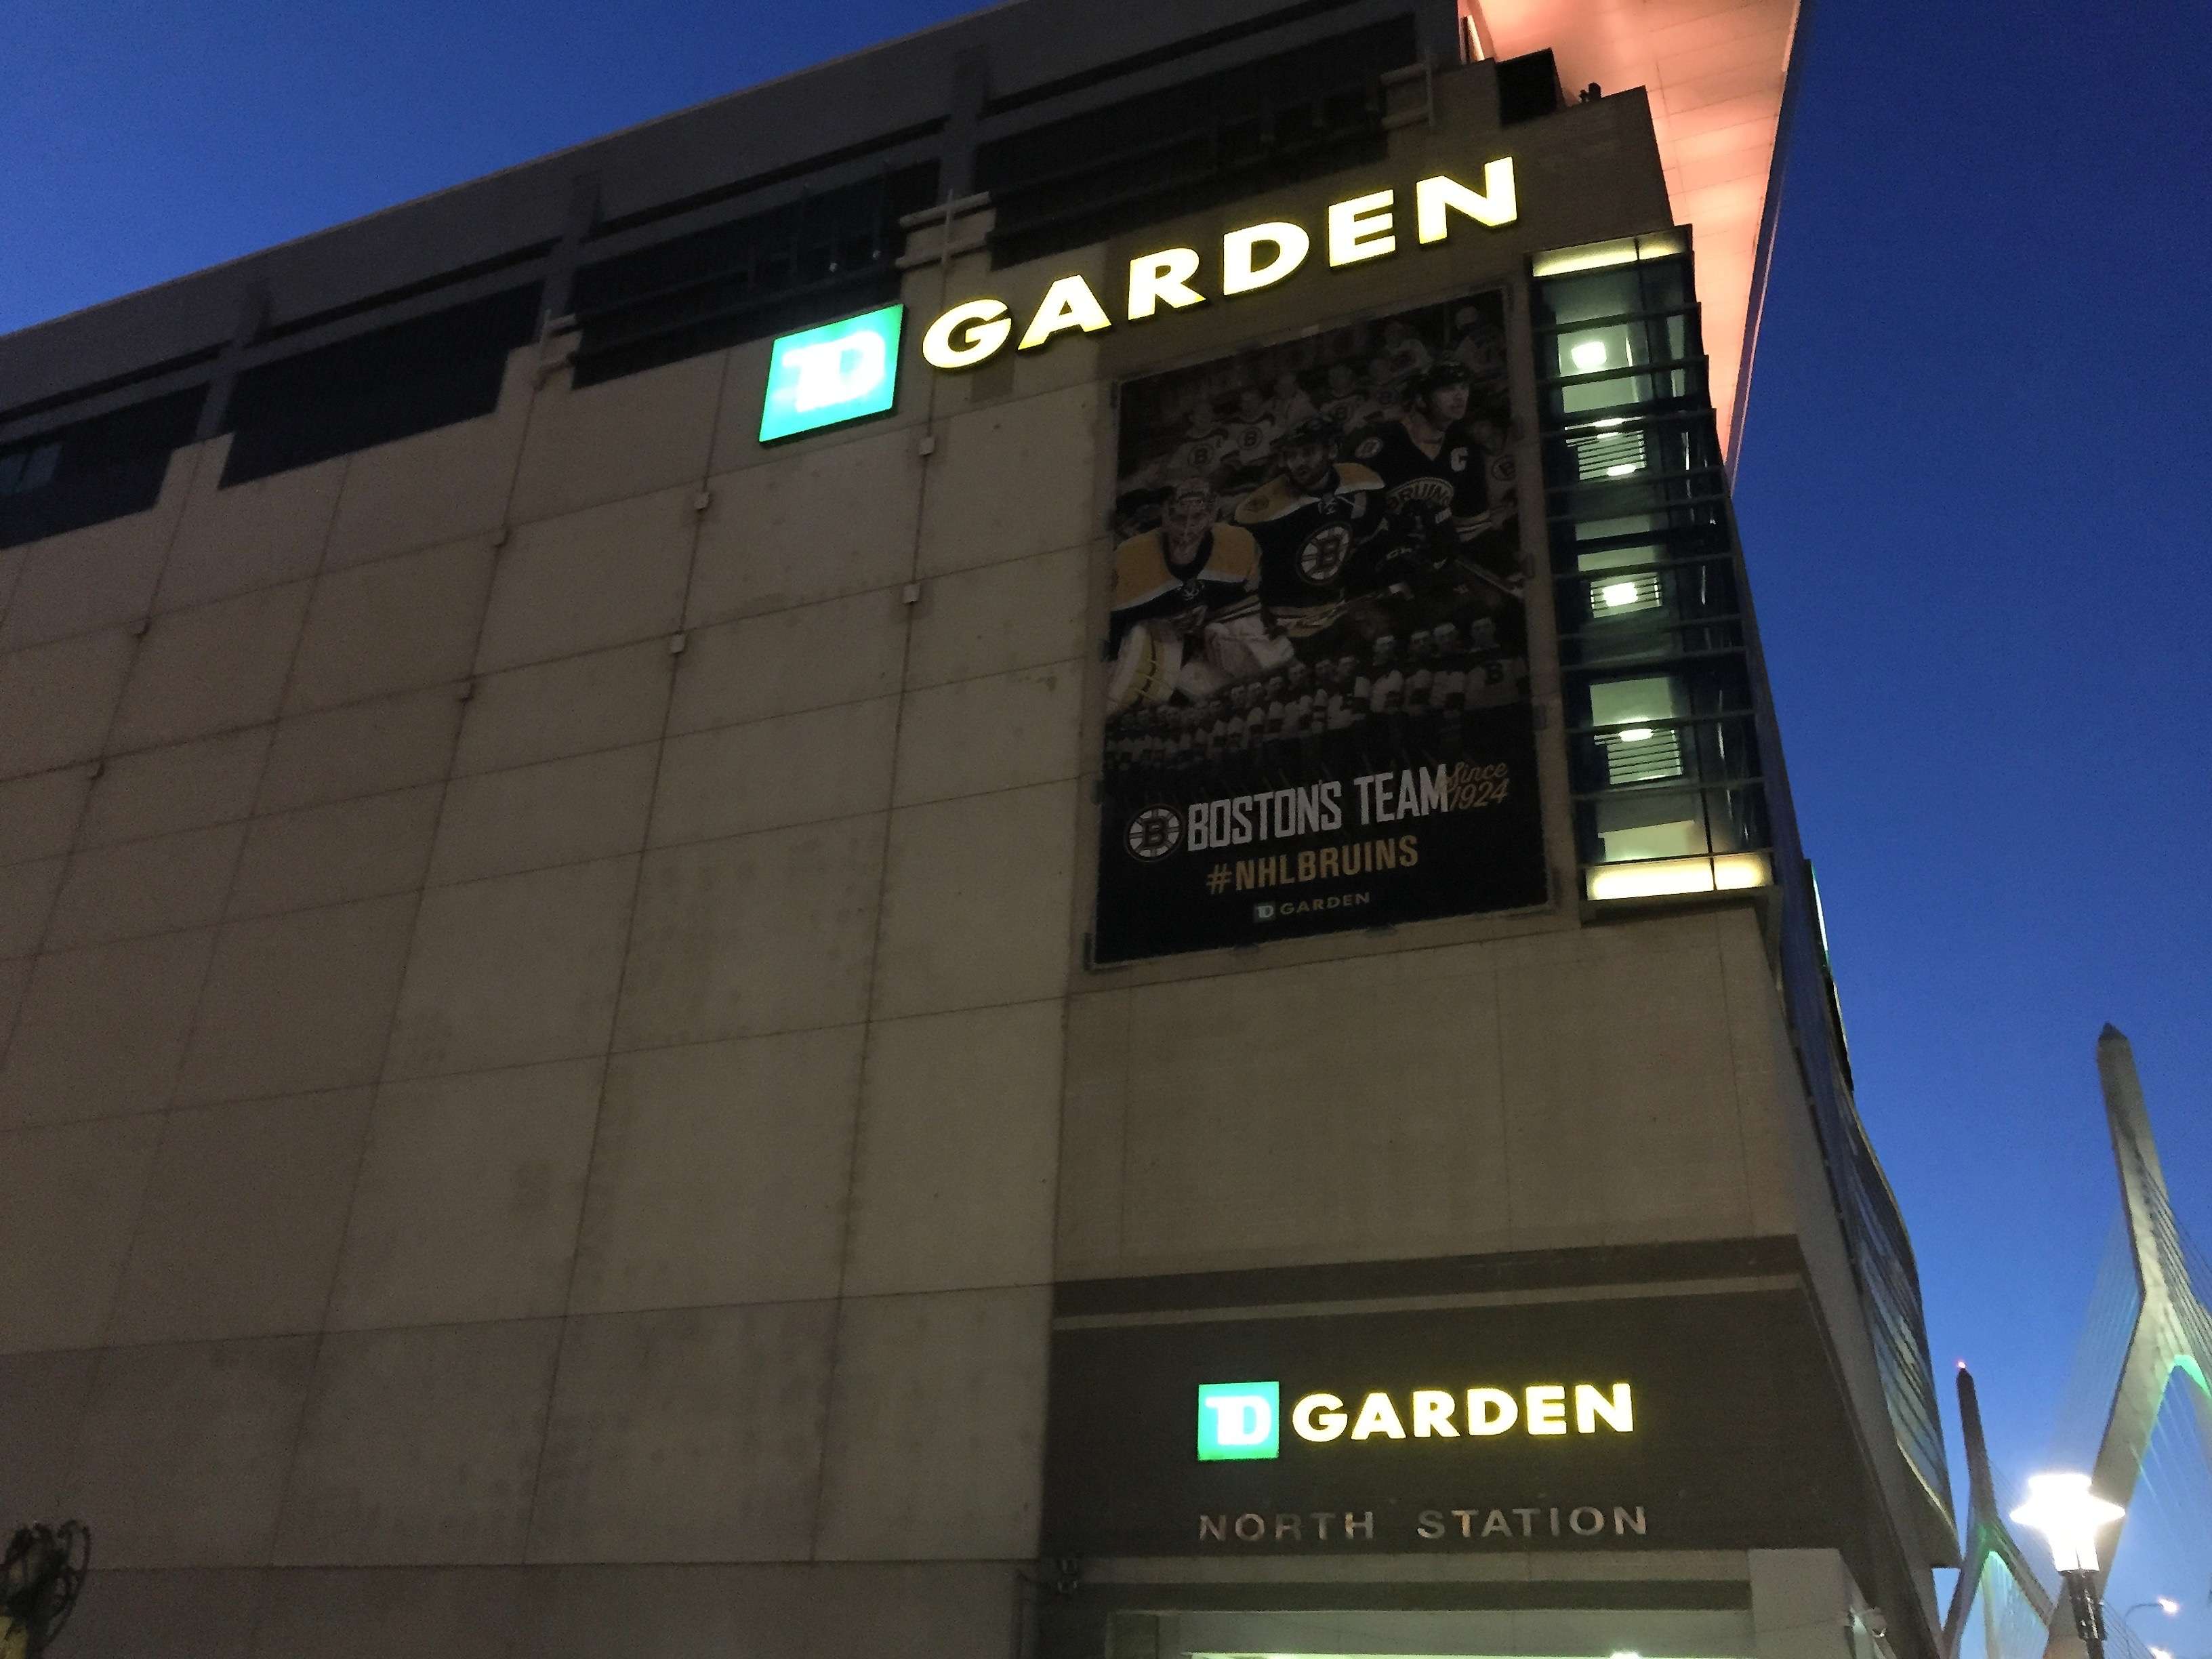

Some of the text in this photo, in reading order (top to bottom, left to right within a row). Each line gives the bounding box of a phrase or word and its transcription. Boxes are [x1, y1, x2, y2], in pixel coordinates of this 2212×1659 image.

[779, 156, 1518, 414] TD GARDEN
[1450, 447, 1469, 472] C
[1446, 761, 1509, 787] Since
[1353, 763, 1450, 825] TEAM
[1450, 777, 1510, 811] 1924
[1206, 834, 1419, 895] #NHLBRUINS
[1256, 891, 1371, 919] TD GARDEN
[1204, 1383, 1634, 1446] TD GARDEN
[1199, 1506, 1647, 1540] NORTH STATION
